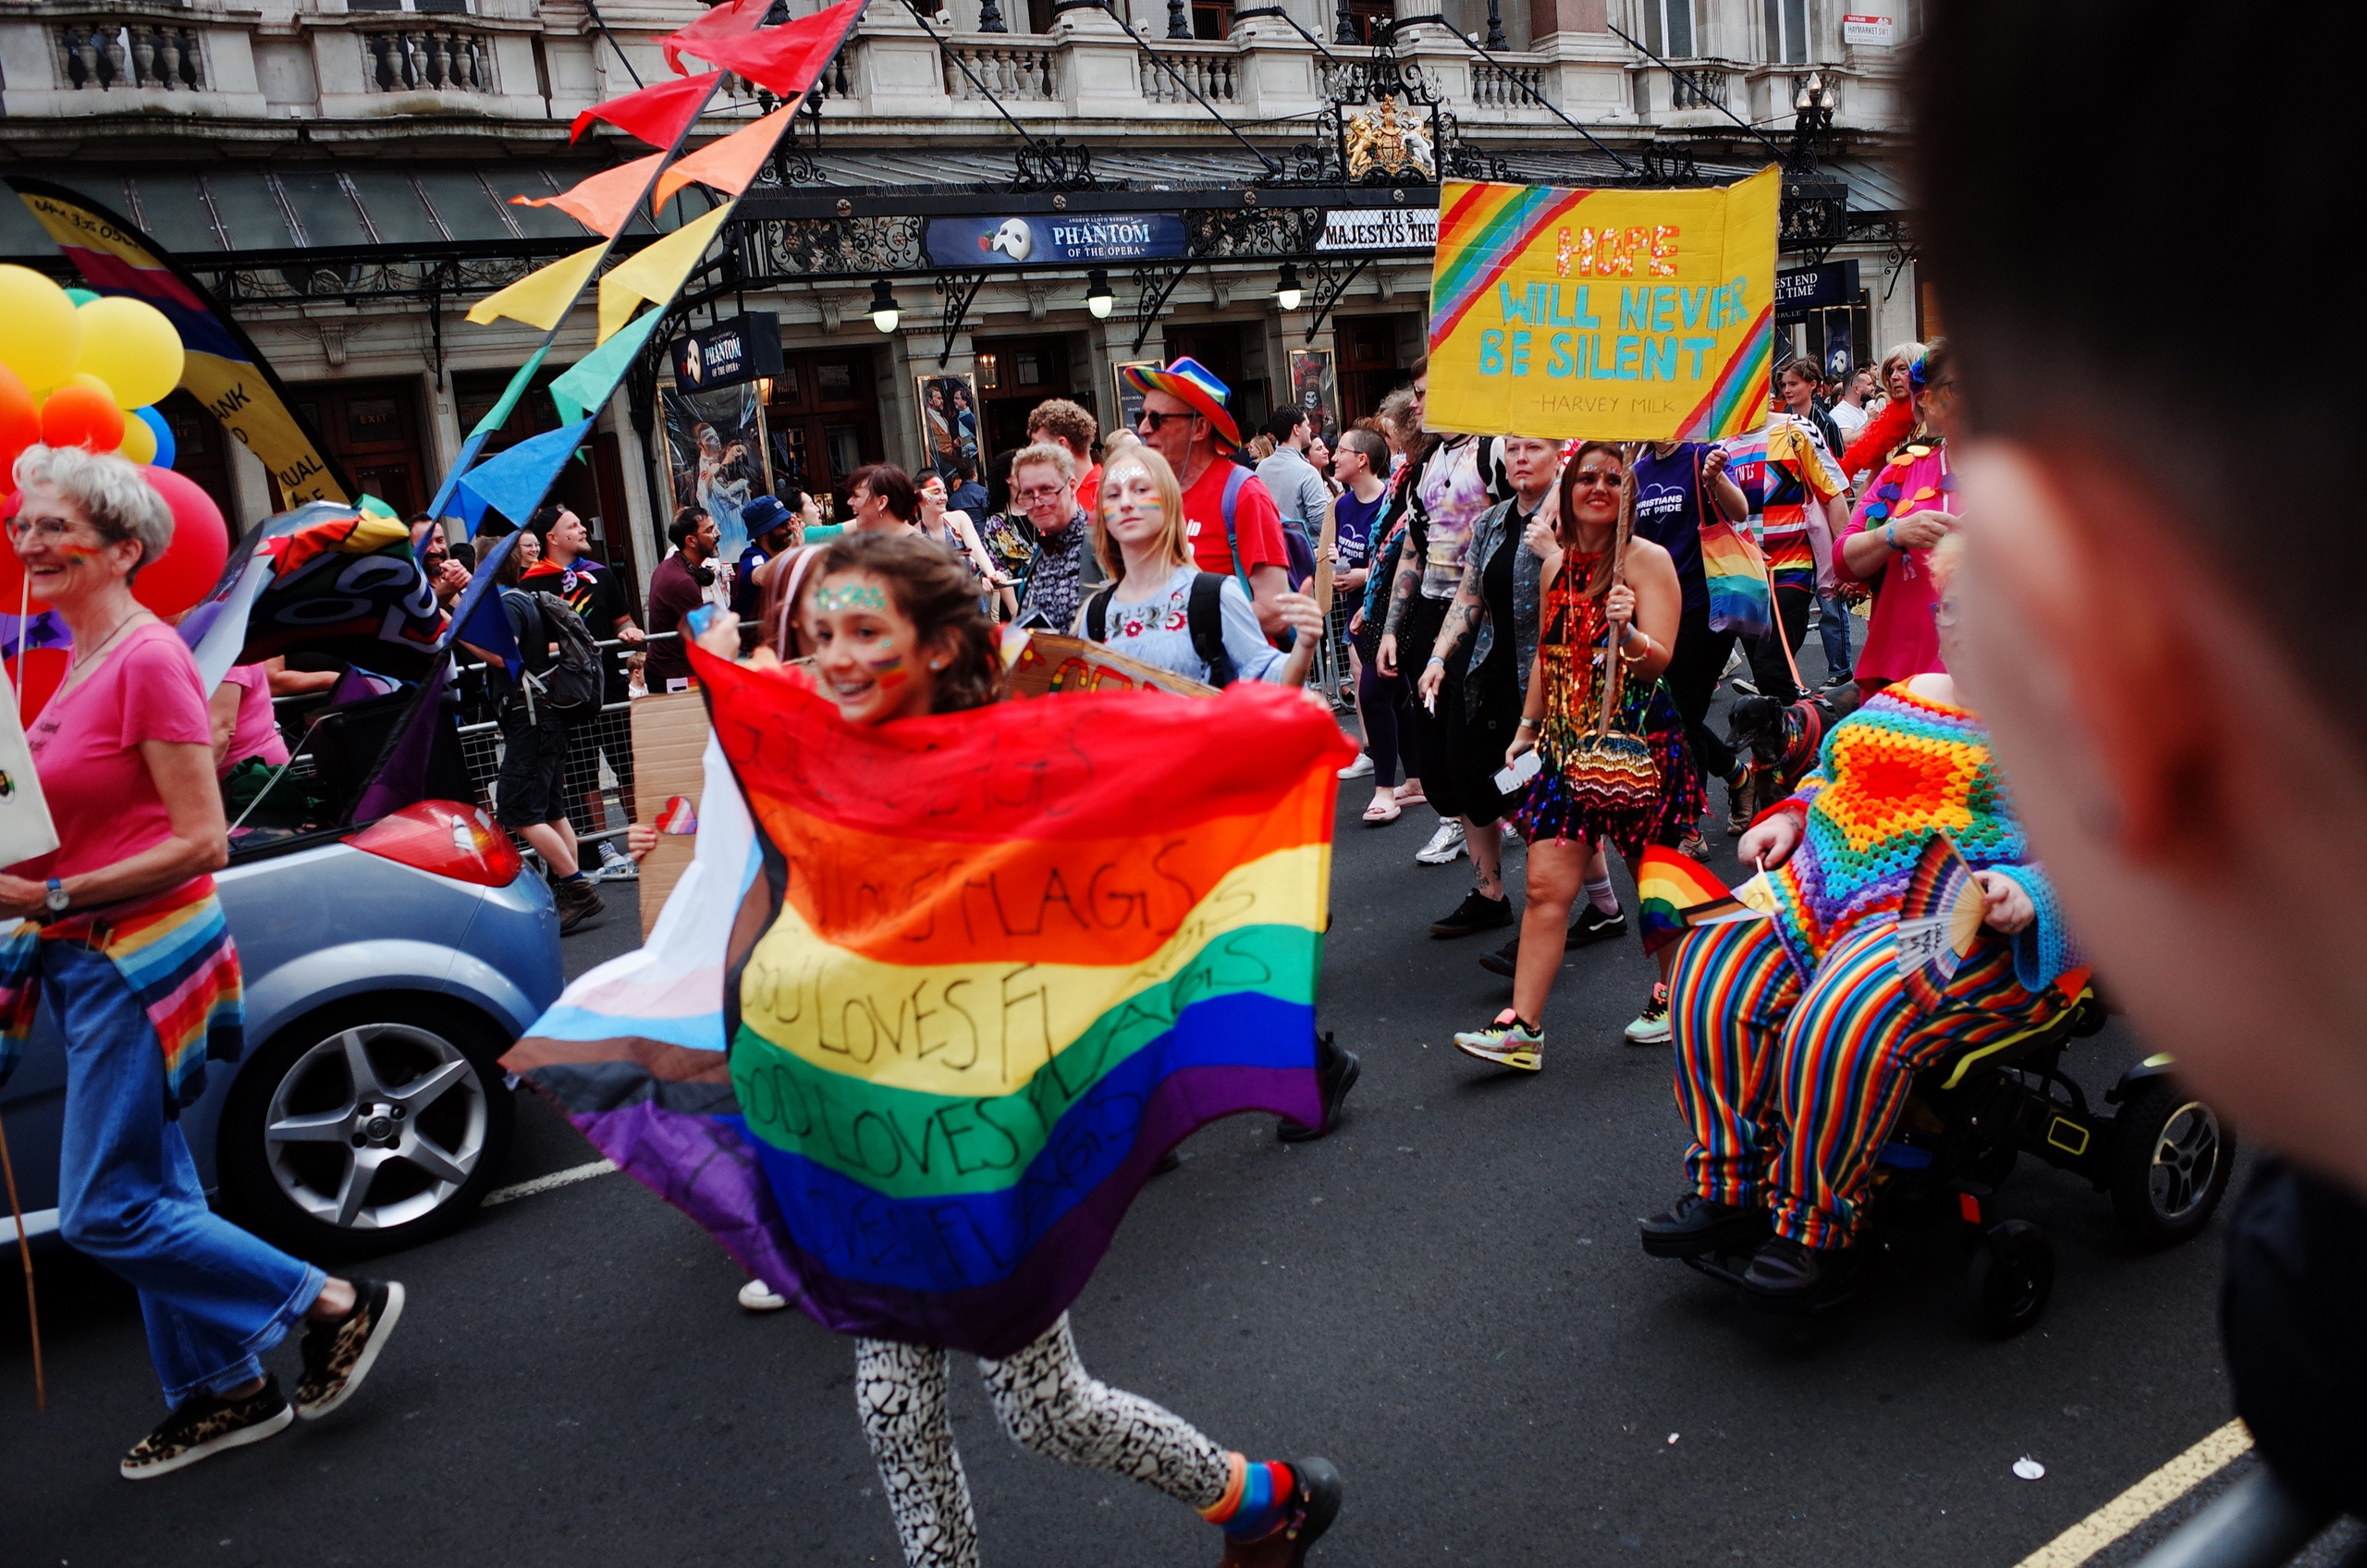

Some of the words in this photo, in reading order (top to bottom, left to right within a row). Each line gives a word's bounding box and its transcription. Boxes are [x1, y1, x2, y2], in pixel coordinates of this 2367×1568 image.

[1847, 26, 1878, 35] HAYMARKET
[1878, 28, 1889, 36] SW1
[1382, 211, 1414, 224] HIS
[1052, 222, 1151, 246] PHANTOM
[1067, 248, 1081, 258] OF
[1085, 247, 1105, 257] THE
[1108, 246, 1141, 256] OPERA
[1556, 225, 1680, 277] HOPE
[1795, 273, 1818, 287] END
[1498, 280, 1601, 329] WILL
[1618, 276, 1750, 333] NEVER
[704, 337, 742, 367] PHANTOM
[1478, 328, 1532, 377] BE
[1546, 332, 1717, 382] SILENT
[711, 367, 717, 378] OF
[1631, 398, 1675, 414] MILK
[360, 413, 388, 425] EXIT
[1639, 508, 1651, 518] AT
[1654, 504, 1682, 515] PRIDE
[1343, 546, 1365, 559] PRIDE
[815, 957, 979, 1072] LOVES
[814, 1084, 1020, 1180] LOVES
